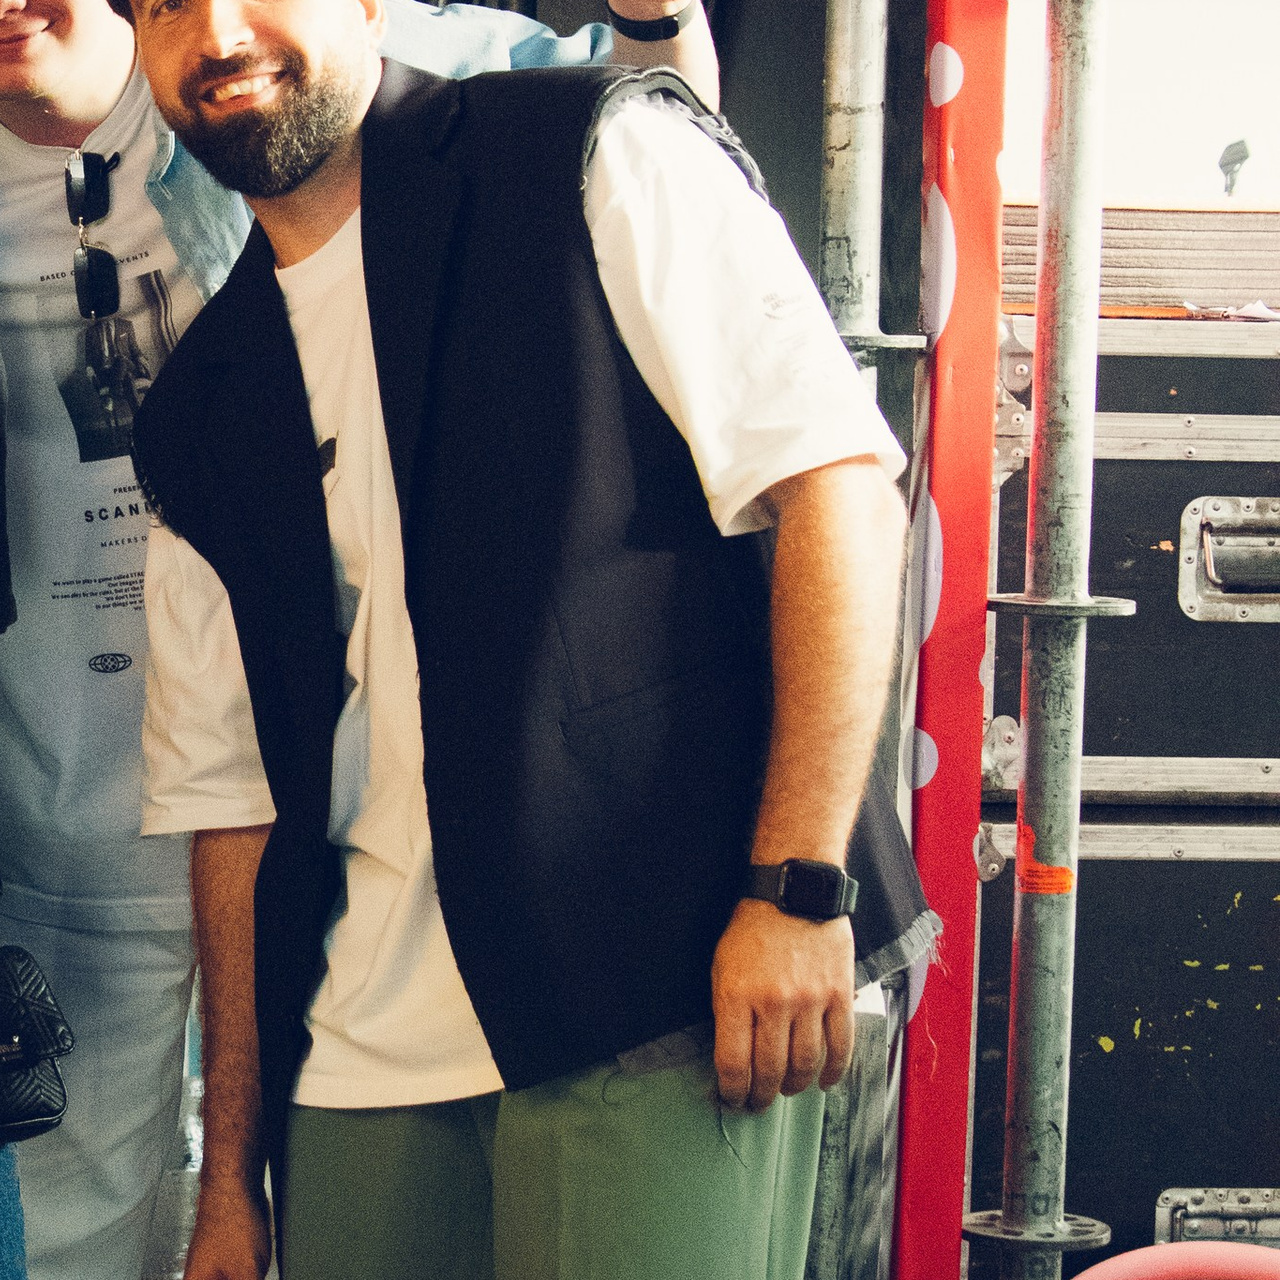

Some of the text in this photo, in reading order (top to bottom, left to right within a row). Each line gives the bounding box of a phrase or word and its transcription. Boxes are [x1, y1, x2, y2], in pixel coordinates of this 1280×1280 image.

[40, 273, 67, 282] BASED
[117, 251, 150, 264] VENTS
[101, 537, 138, 547] MAKERS
